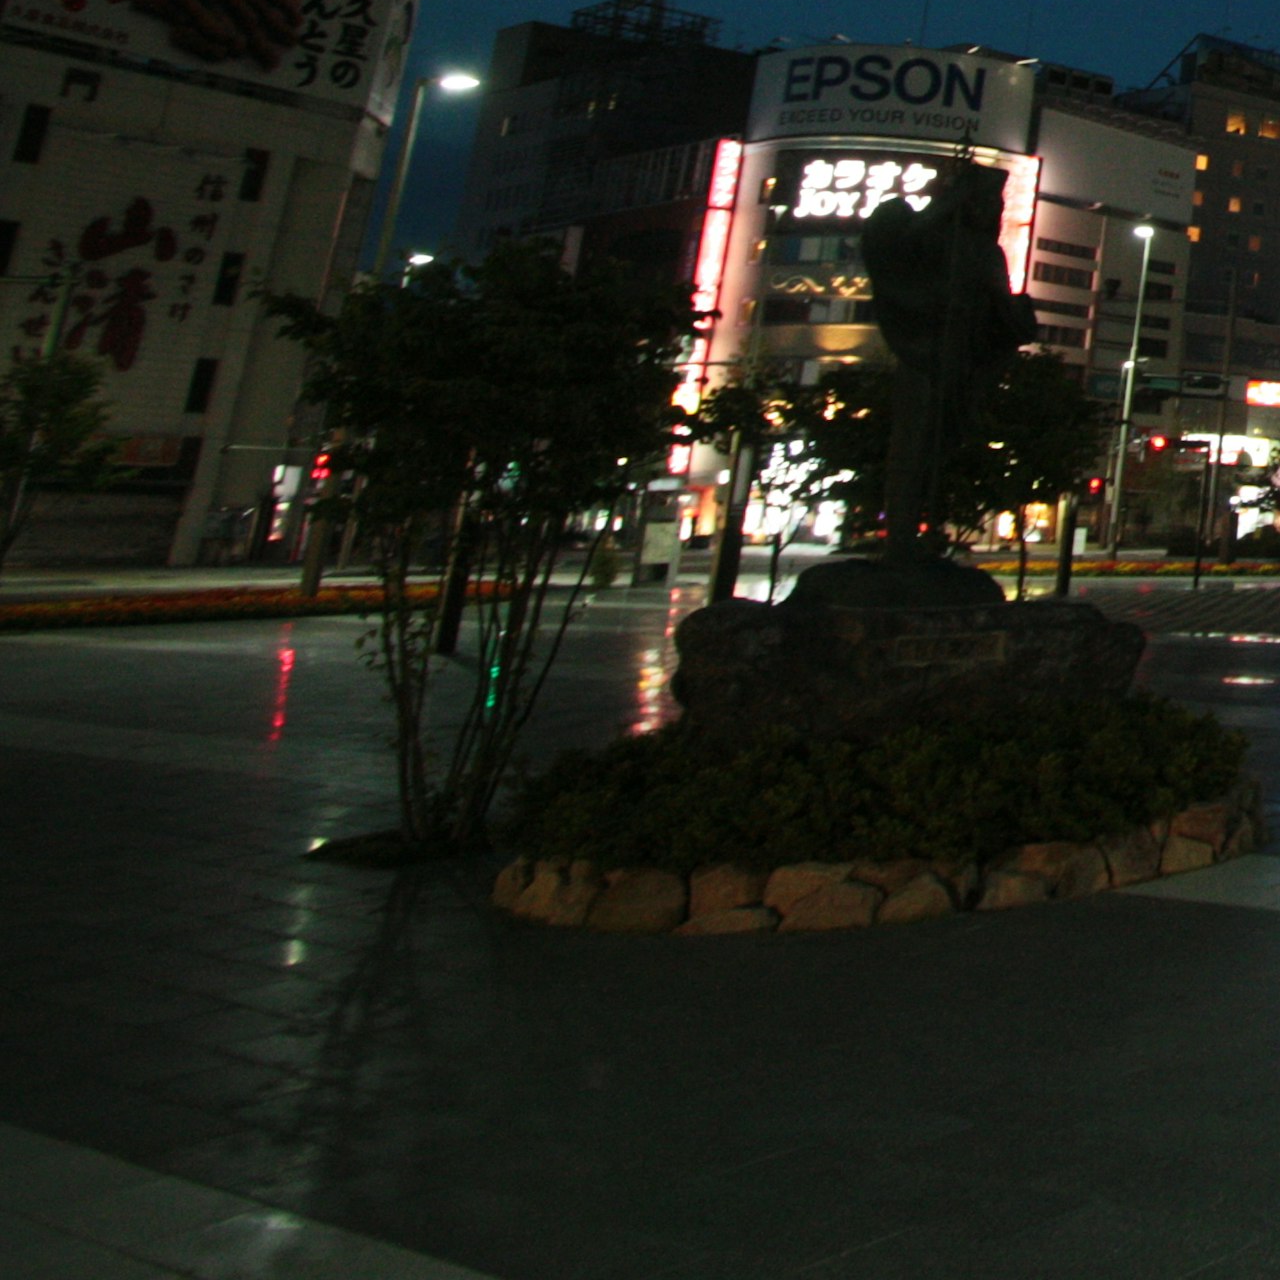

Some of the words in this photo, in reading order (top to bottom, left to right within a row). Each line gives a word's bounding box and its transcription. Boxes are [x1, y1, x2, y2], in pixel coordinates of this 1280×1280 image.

[783, 55, 986, 111] EPSON
[779, 107, 843, 126] EXCEED
[849, 107, 906, 125] YOUR
[912, 110, 979, 133] VISION
[801, 160, 937, 192] カラオケ
[793, 189, 860, 218] JOY
[859, 189, 932, 218] JY
